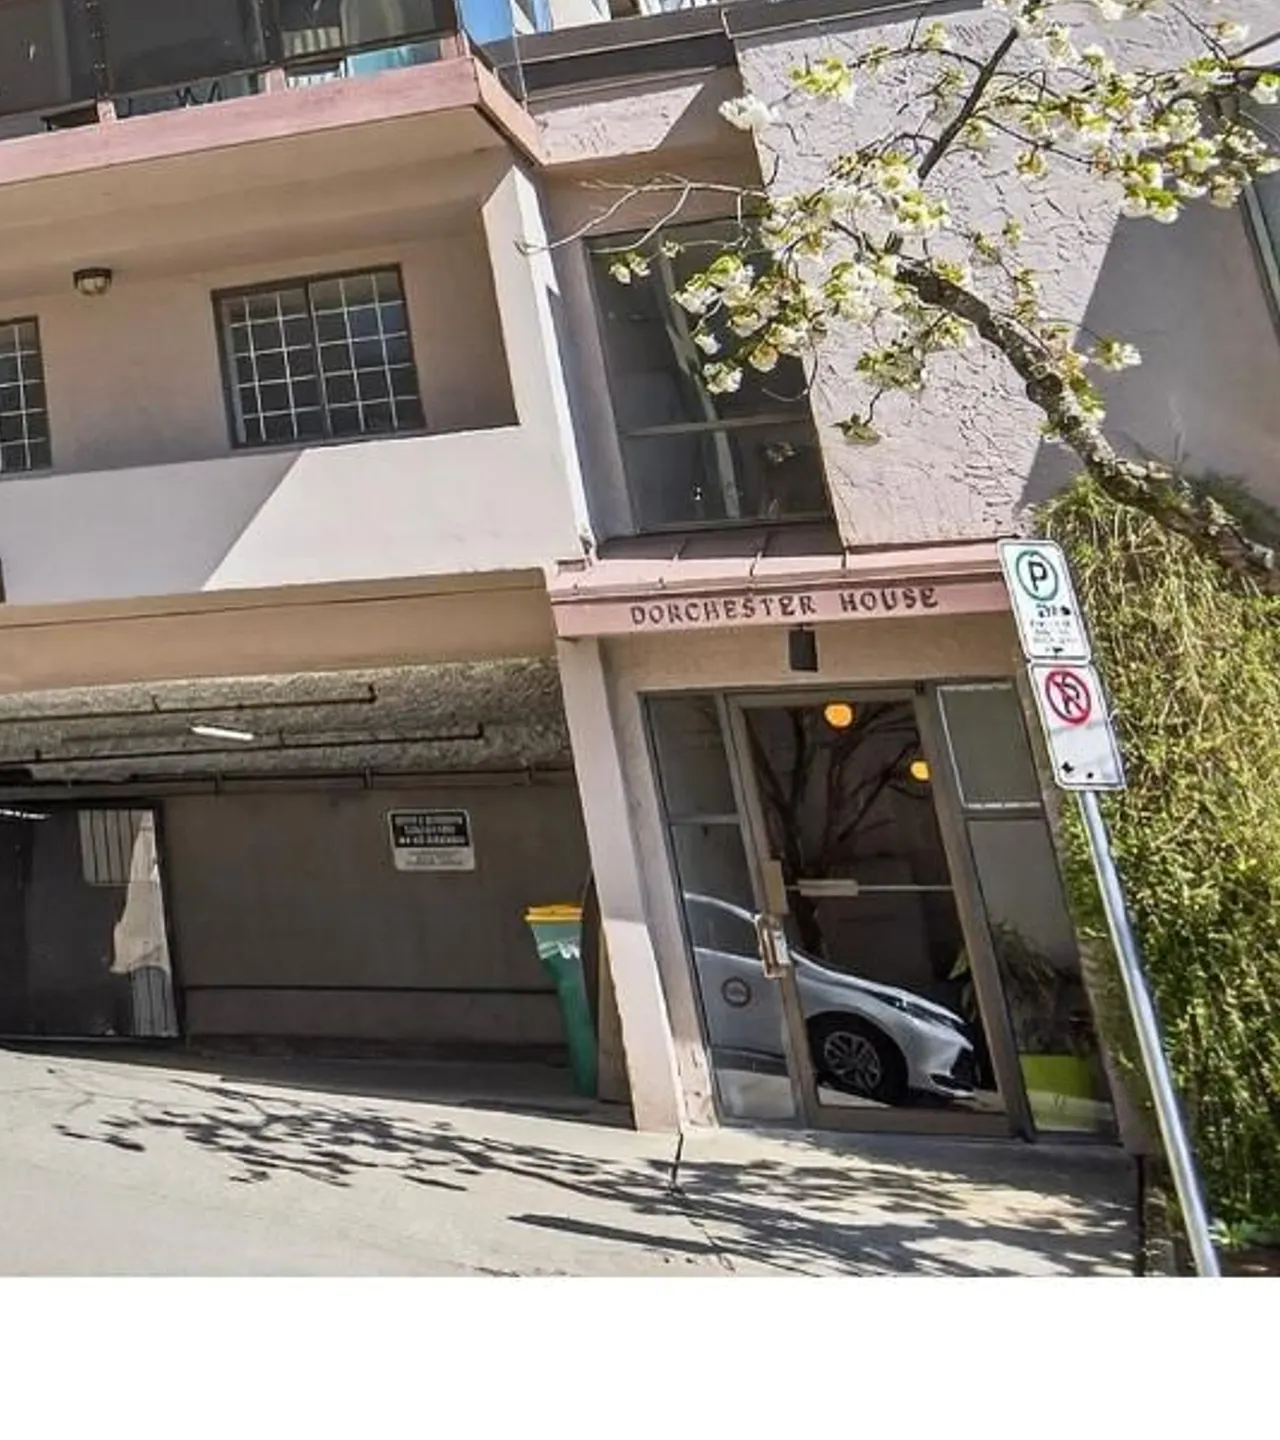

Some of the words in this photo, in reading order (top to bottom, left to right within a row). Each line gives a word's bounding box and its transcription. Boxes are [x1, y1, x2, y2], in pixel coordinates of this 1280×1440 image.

[1027, 560, 1048, 592] P
[630, 594, 818, 625] DORCHESTER
[839, 587, 939, 613] HOUSE
